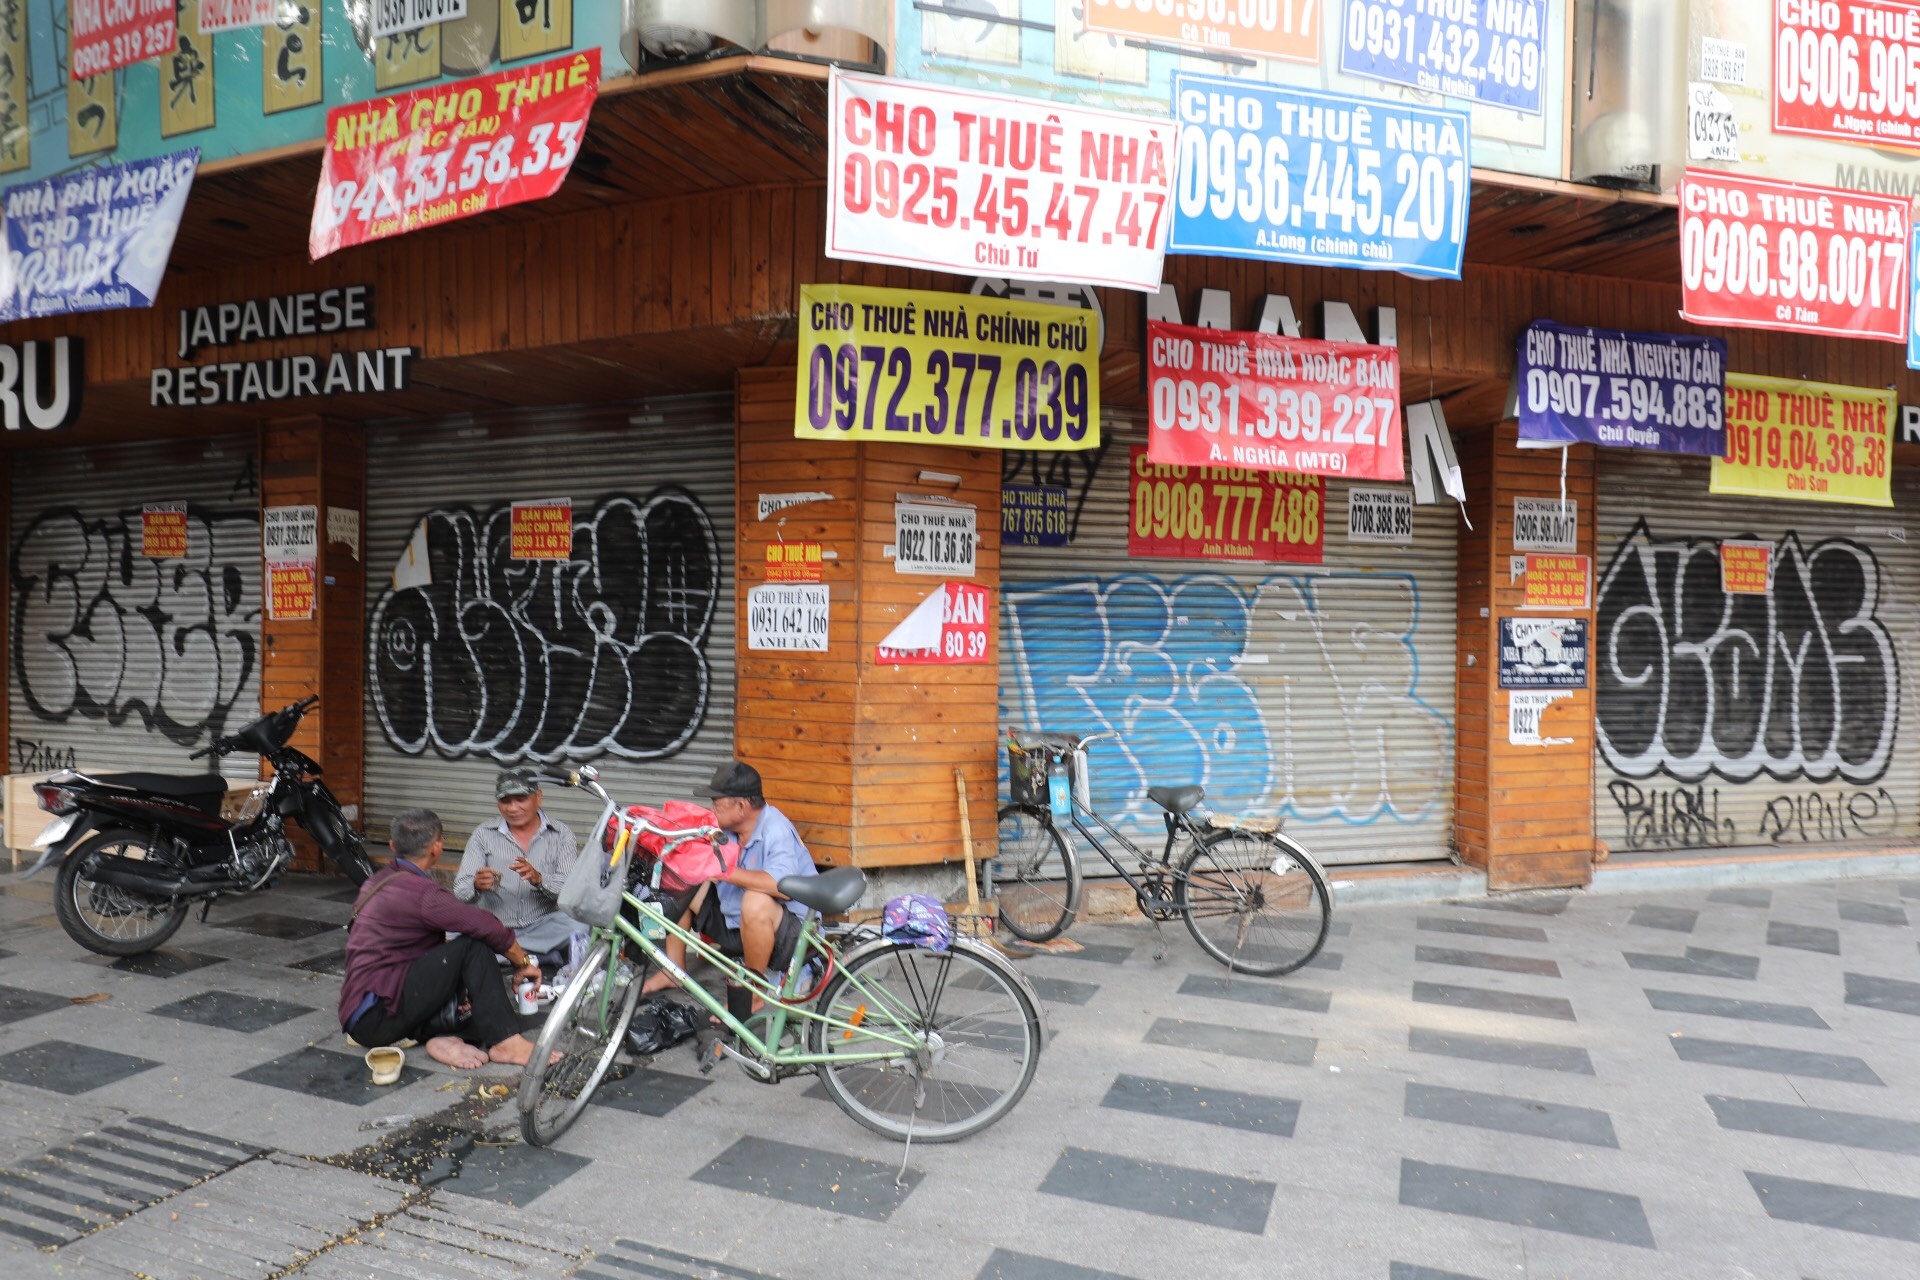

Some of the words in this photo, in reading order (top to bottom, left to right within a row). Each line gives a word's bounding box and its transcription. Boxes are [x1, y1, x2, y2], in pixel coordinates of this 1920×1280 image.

[1779, 0, 1840, 30] CHO
[74, 41, 110, 76] 0902
[113, 31, 142, 63] 319
[145, 20, 174, 54] 257
[1348, 4, 1538, 91] 0931.432.469
[334, 98, 399, 152] NHÀ
[411, 88, 482, 132] CHO
[845, 96, 936, 157] CHO
[953, 111, 1064, 174] THUÊ
[1080, 129, 1168, 188] NHÀ
[1180, 89, 1263, 131] CHO
[1276, 101, 1372, 146] THUÊ
[1386, 115, 1464, 157] NHÀ
[8, 180, 56, 219] NHÀ
[844, 151, 1166, 250] 0925.45.47.47
[1179, 125, 1464, 245] 0936.445.201
[28, 215, 79, 250] CHO
[1685, 184, 1749, 218] CHO
[1757, 195, 1834, 229] THUÊ
[1843, 205, 1904, 239] NHÀ
[1256, 228, 1306, 254] A.Long
[1311, 234, 1358, 257] (chính
[1684, 216, 1904, 310] 0906.98.0017
[177, 285, 367, 358] JAPANESE
[811, 301, 854, 331] CHO
[862, 300, 917, 336] THUÊ
[924, 304, 969, 339] NHÀ
[976, 311, 1040, 347] CHÍNH
[1047, 315, 1088, 352] CHỦ
[1152, 336, 1193, 372] CHO
[1201, 343, 1250, 376] THUÊ
[1256, 345, 1297, 380] NHÀ
[1302, 350, 1350, 390] HOẶC
[1356, 353, 1394, 389] BÁN
[1527, 327, 1556, 368] CHO
[1559, 328, 1598, 372] THUÊ
[1600, 332, 1632, 376] NHÀ
[151, 346, 412, 407] RESTAURANT
[808, 342, 1090, 442] 0972.377.039
[1527, 367, 1723, 431] 0907.594.883
[1153, 376, 1395, 447] 0931.339.227
[1776, 391, 1834, 430] THUÊ
[1843, 397, 1887, 436] NHÀ
[1209, 442, 1229, 462] A.
[1233, 444, 1290, 468] NGHĨA
[1295, 449, 1348, 475] (MTG)
[1722, 421, 1886, 479] 0919.04.38.38
[1001, 489, 1016, 505] HO
[1019, 486, 1044, 508] THUÊ
[1046, 489, 1067, 508] NHÀ
[1135, 480, 1319, 546] 0908.777.488
[1351, 503, 1412, 535] 0708.388.993
[1353, 492, 1371, 502] CHO
[1518, 502, 1534, 512] CHO
[535, 534, 545, 548] 11
[901, 512, 920, 525] CHO
[922, 512, 946, 526] THUÊ
[949, 513, 968, 528] NHÀ
[1002, 507, 1022, 534] 767
[1024, 508, 1043, 534] 875
[1046, 509, 1066, 535] 618
[766, 544, 783, 562] CHO
[900, 528, 972, 566] 0922.16.36.36
[1202, 543, 1222, 556] Anh
[754, 590, 776, 604] CHO
[778, 587, 804, 605] THUÊ
[805, 588, 827, 605] NHÀ
[752, 605, 777, 632] 0931
[782, 606, 802, 633] 642
[807, 606, 828, 634] 166
[756, 636, 787, 649] ANH
[945, 630, 964, 658] 80
[967, 630, 987, 658] 39
